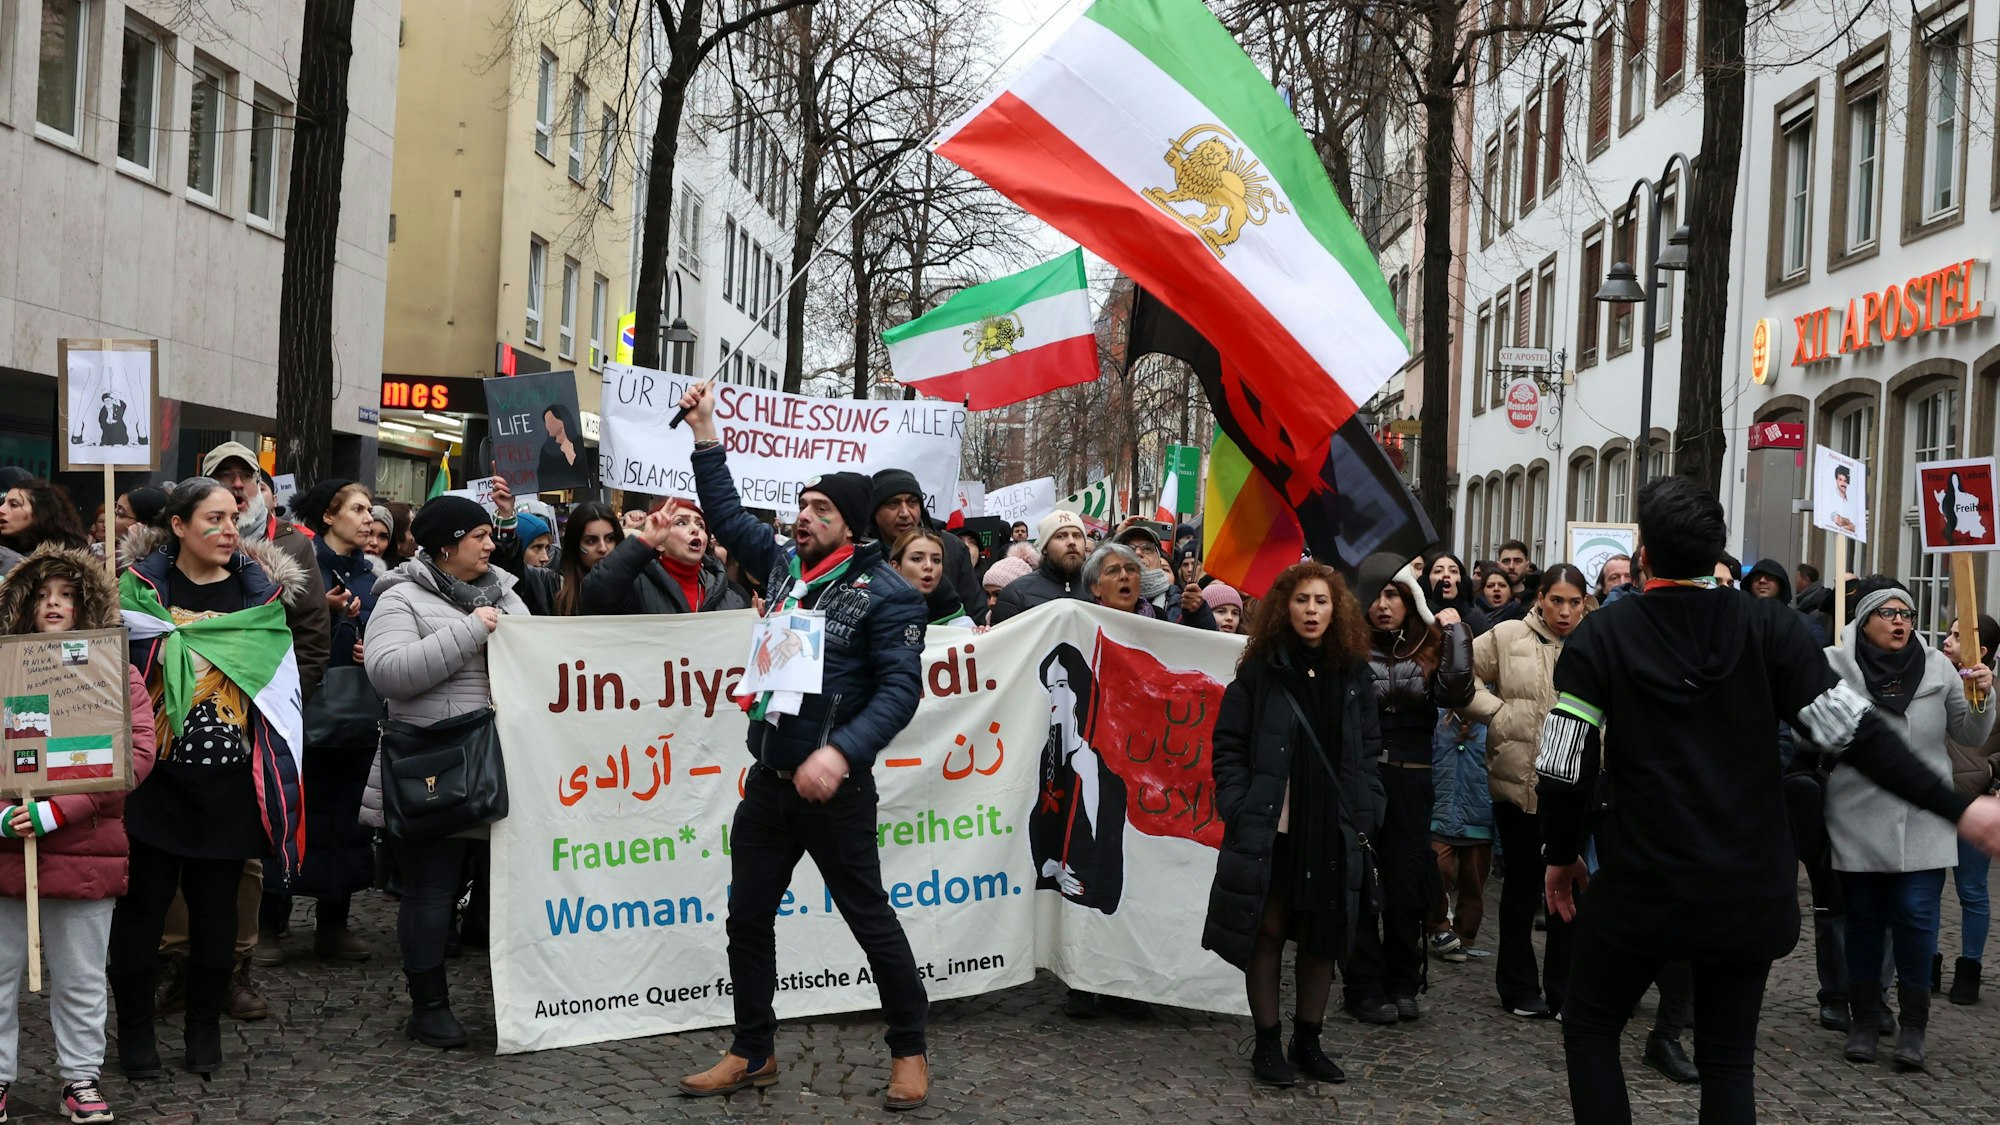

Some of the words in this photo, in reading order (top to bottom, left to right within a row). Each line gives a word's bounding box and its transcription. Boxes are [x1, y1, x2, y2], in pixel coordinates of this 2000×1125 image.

[1791, 307, 1831, 367] XII
[1840, 258, 1983, 354] APOSTEL
[1515, 353, 1549, 361] APOSTEL
[383, 382, 448, 409] mes
[495, 386, 559, 411] WOMEN
[497, 413, 533, 436] LIFE
[585, 419, 600, 436] KIOS
[715, 387, 889, 434] SCHLIESSUNG
[897, 409, 967, 440] ALLER
[497, 443, 533, 464] FREE
[722, 427, 867, 464] BOTSCHAFTEN
[741, 477, 806, 505] REGIER
[993, 487, 1035, 508] ALLER
[1004, 504, 1028, 520] DER
[549, 660, 640, 713] Jin.
[658, 658, 747, 718] Jiya.
[16, 750, 36, 758] FREE
[943, 721, 1004, 780] زن
[558, 733, 675, 806] آزادی
[875, 805, 1013, 847] reiheit.
[546, 896, 715, 936] Woman.
[535, 993, 639, 1019] Autonome
[646, 984, 712, 1006] Queer
[715, 968, 850, 998] feistische
[856, 953, 1005, 986] Ast_innen
